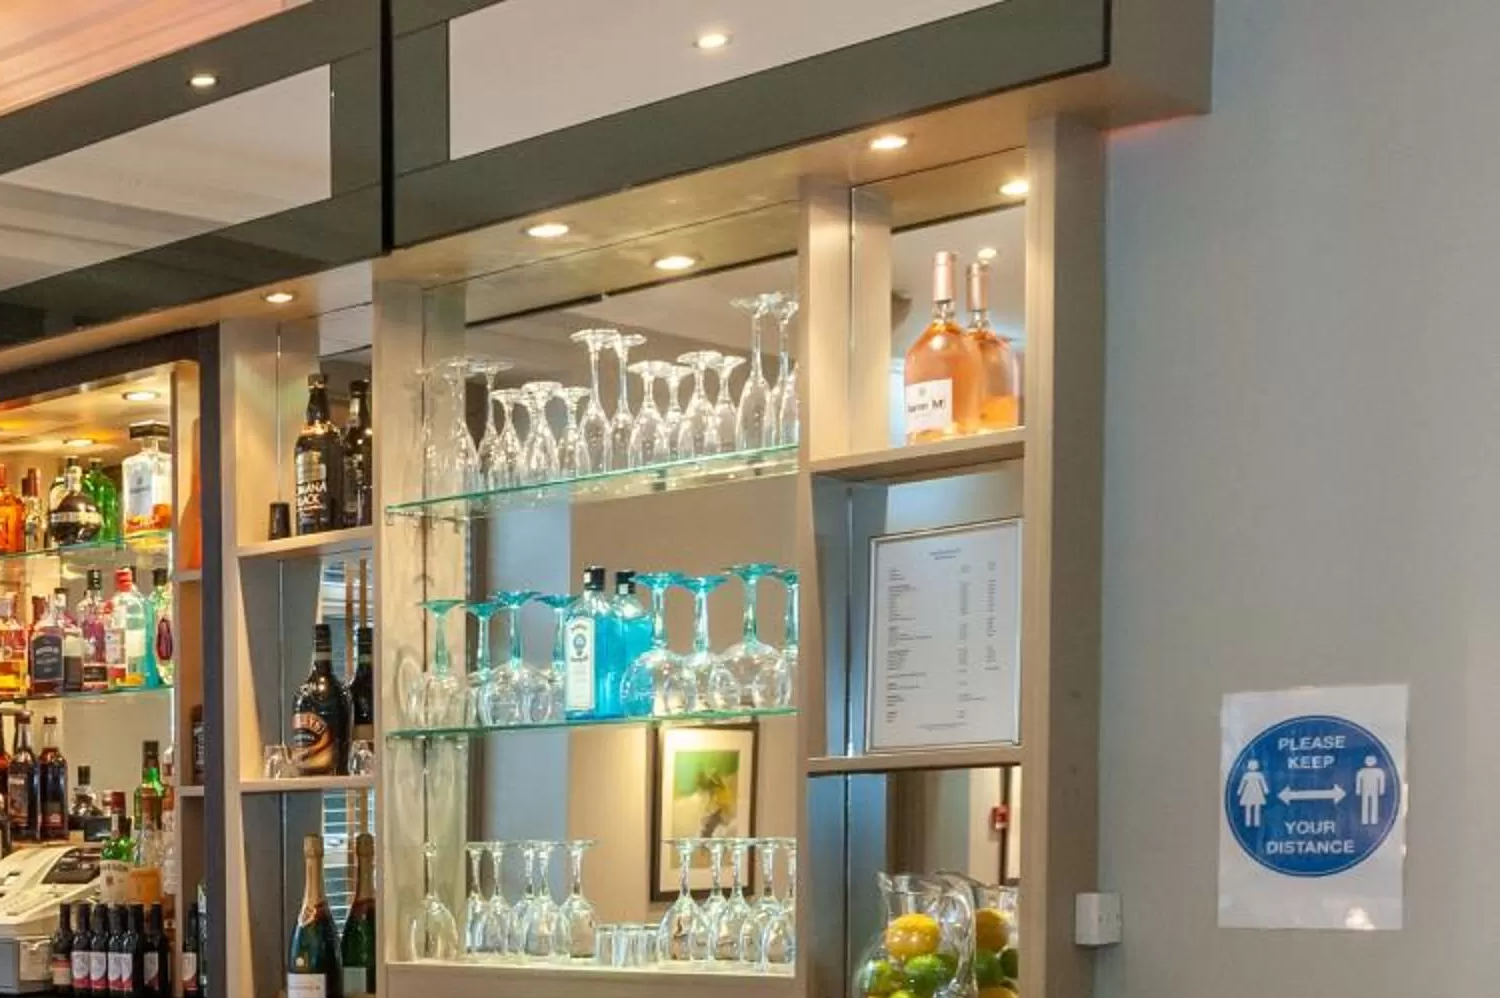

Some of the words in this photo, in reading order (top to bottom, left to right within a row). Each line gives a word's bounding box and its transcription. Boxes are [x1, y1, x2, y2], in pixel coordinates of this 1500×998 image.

[1277, 735, 1347, 751] PLEASE
[1287, 754, 1336, 770] KEEP
[1283, 819, 1336, 836] YOUR
[1266, 839, 1355, 855] DISTANCE
